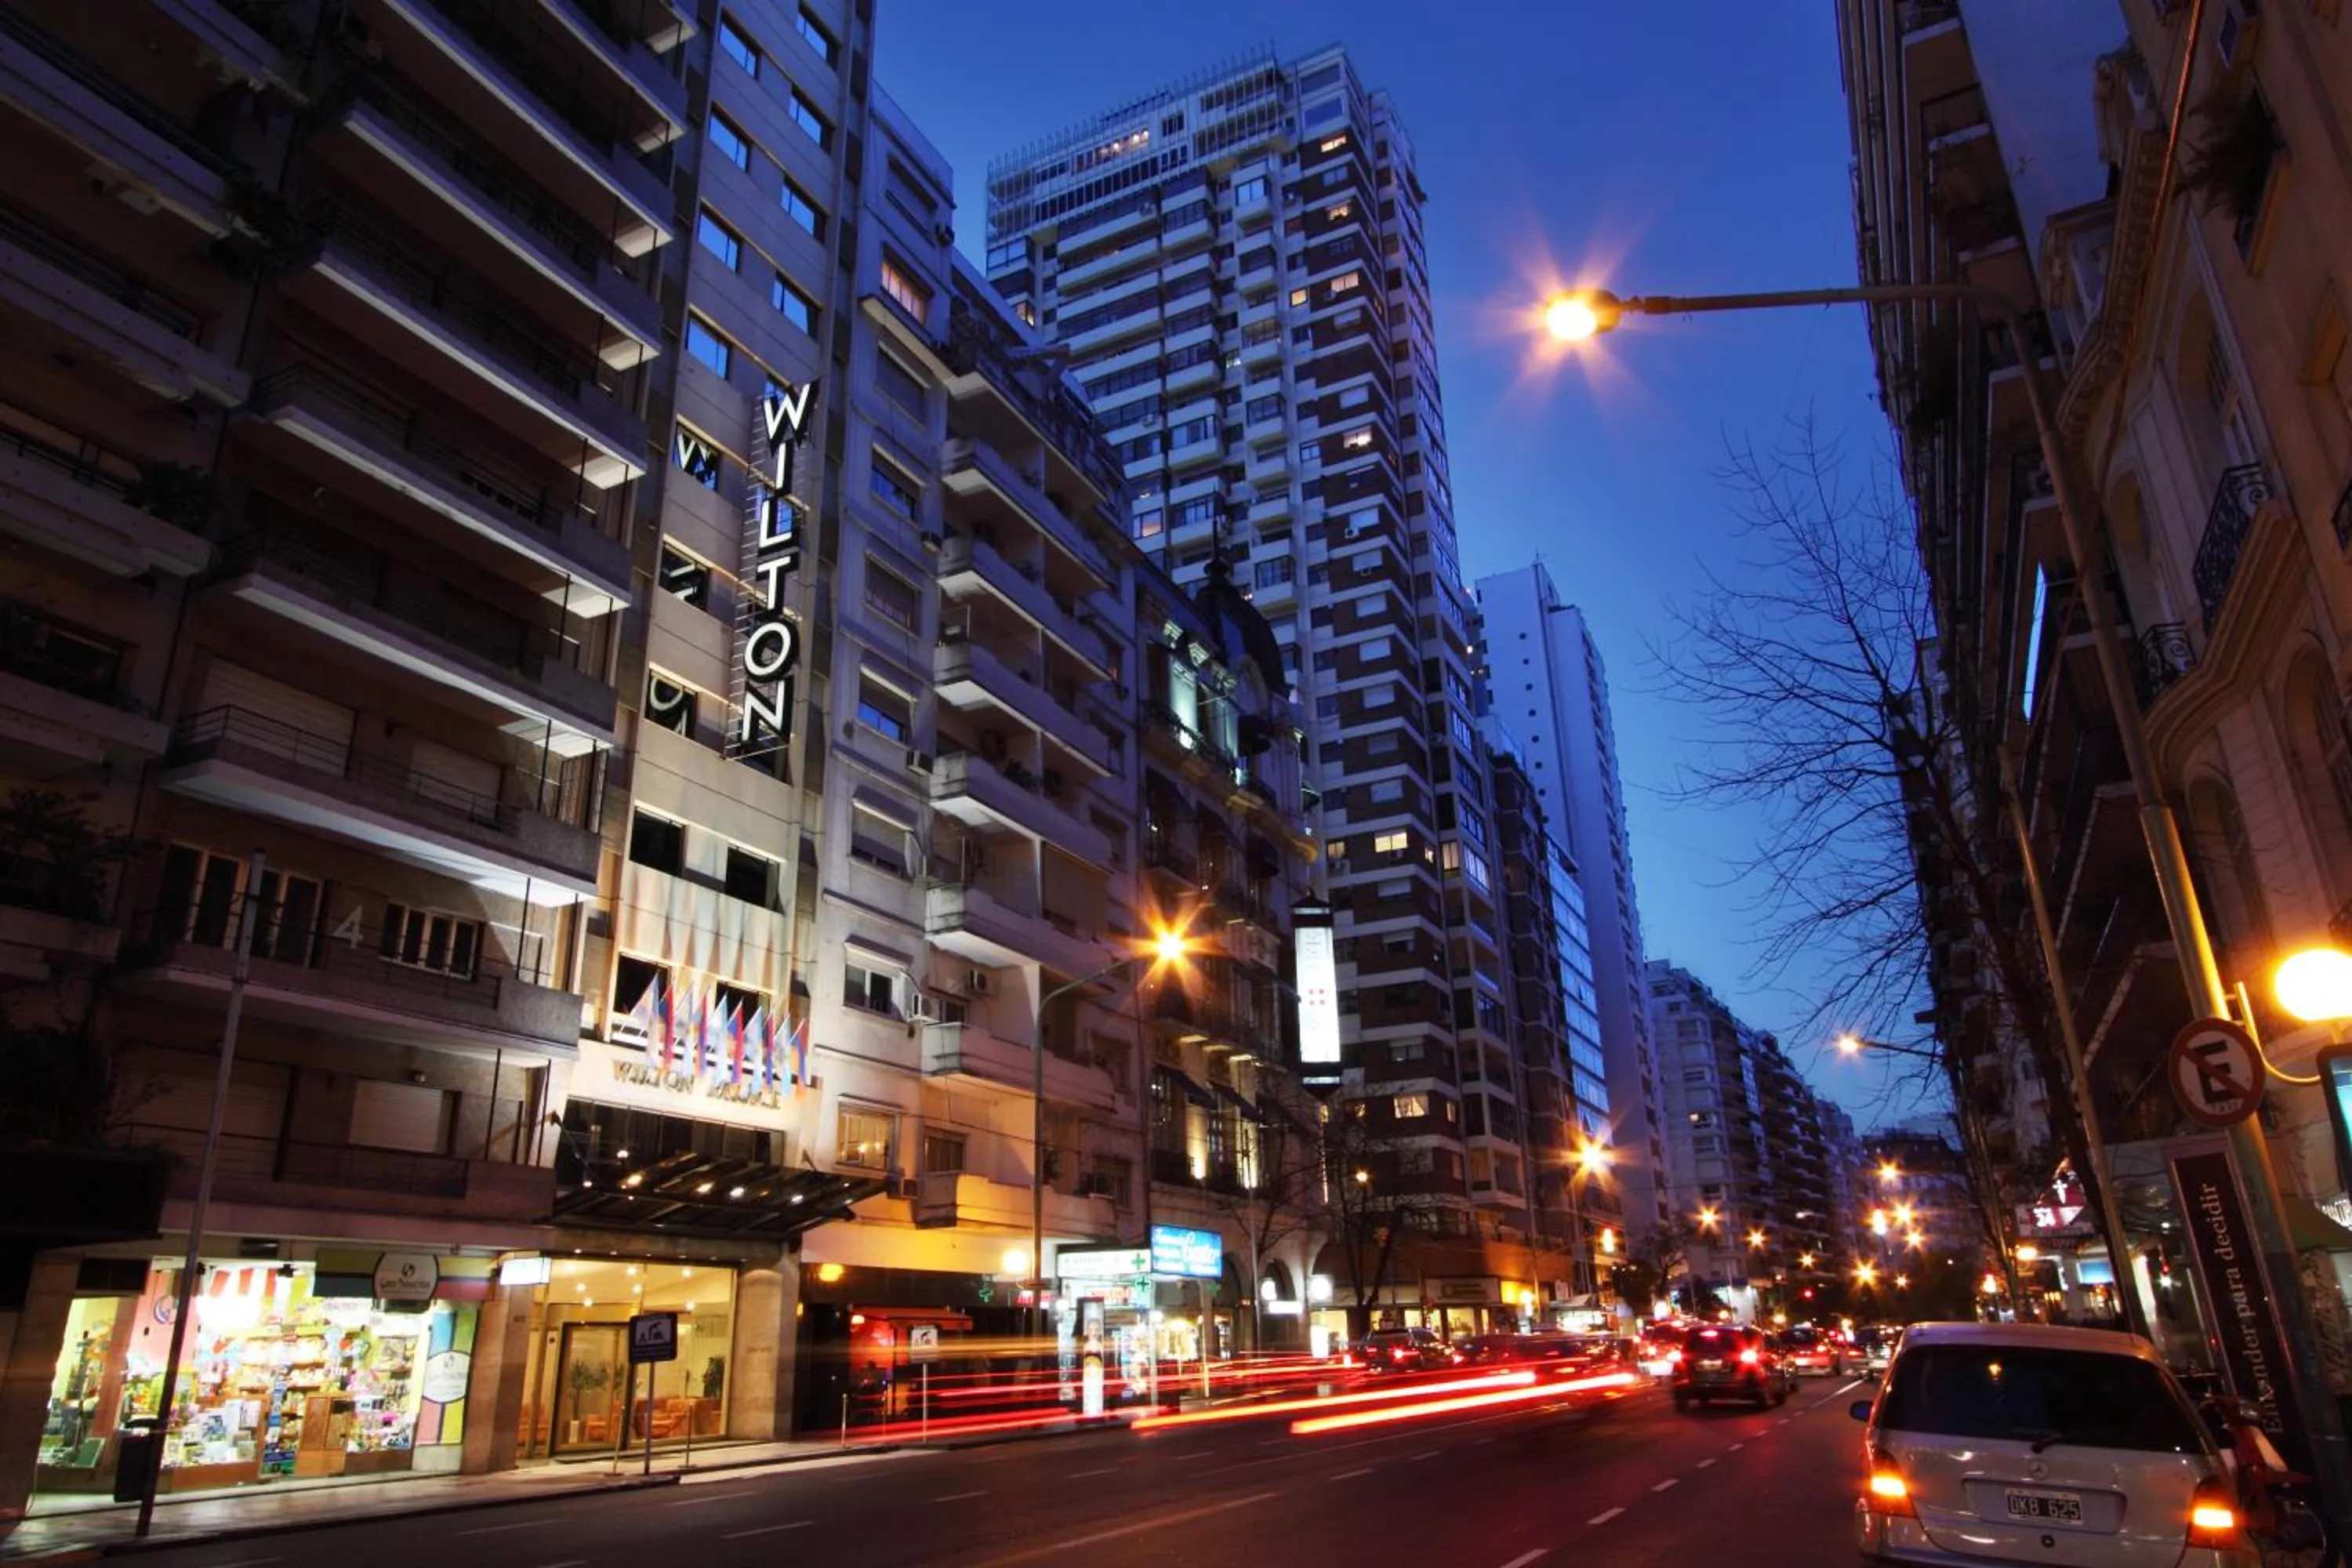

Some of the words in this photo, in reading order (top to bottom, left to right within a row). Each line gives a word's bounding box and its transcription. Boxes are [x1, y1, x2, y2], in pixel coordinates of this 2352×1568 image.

[742, 382, 816, 745] WILTON
[332, 904, 364, 949] 4
[2201, 1182, 2234, 1261] decidir
[2225, 1265, 2256, 1319] para
